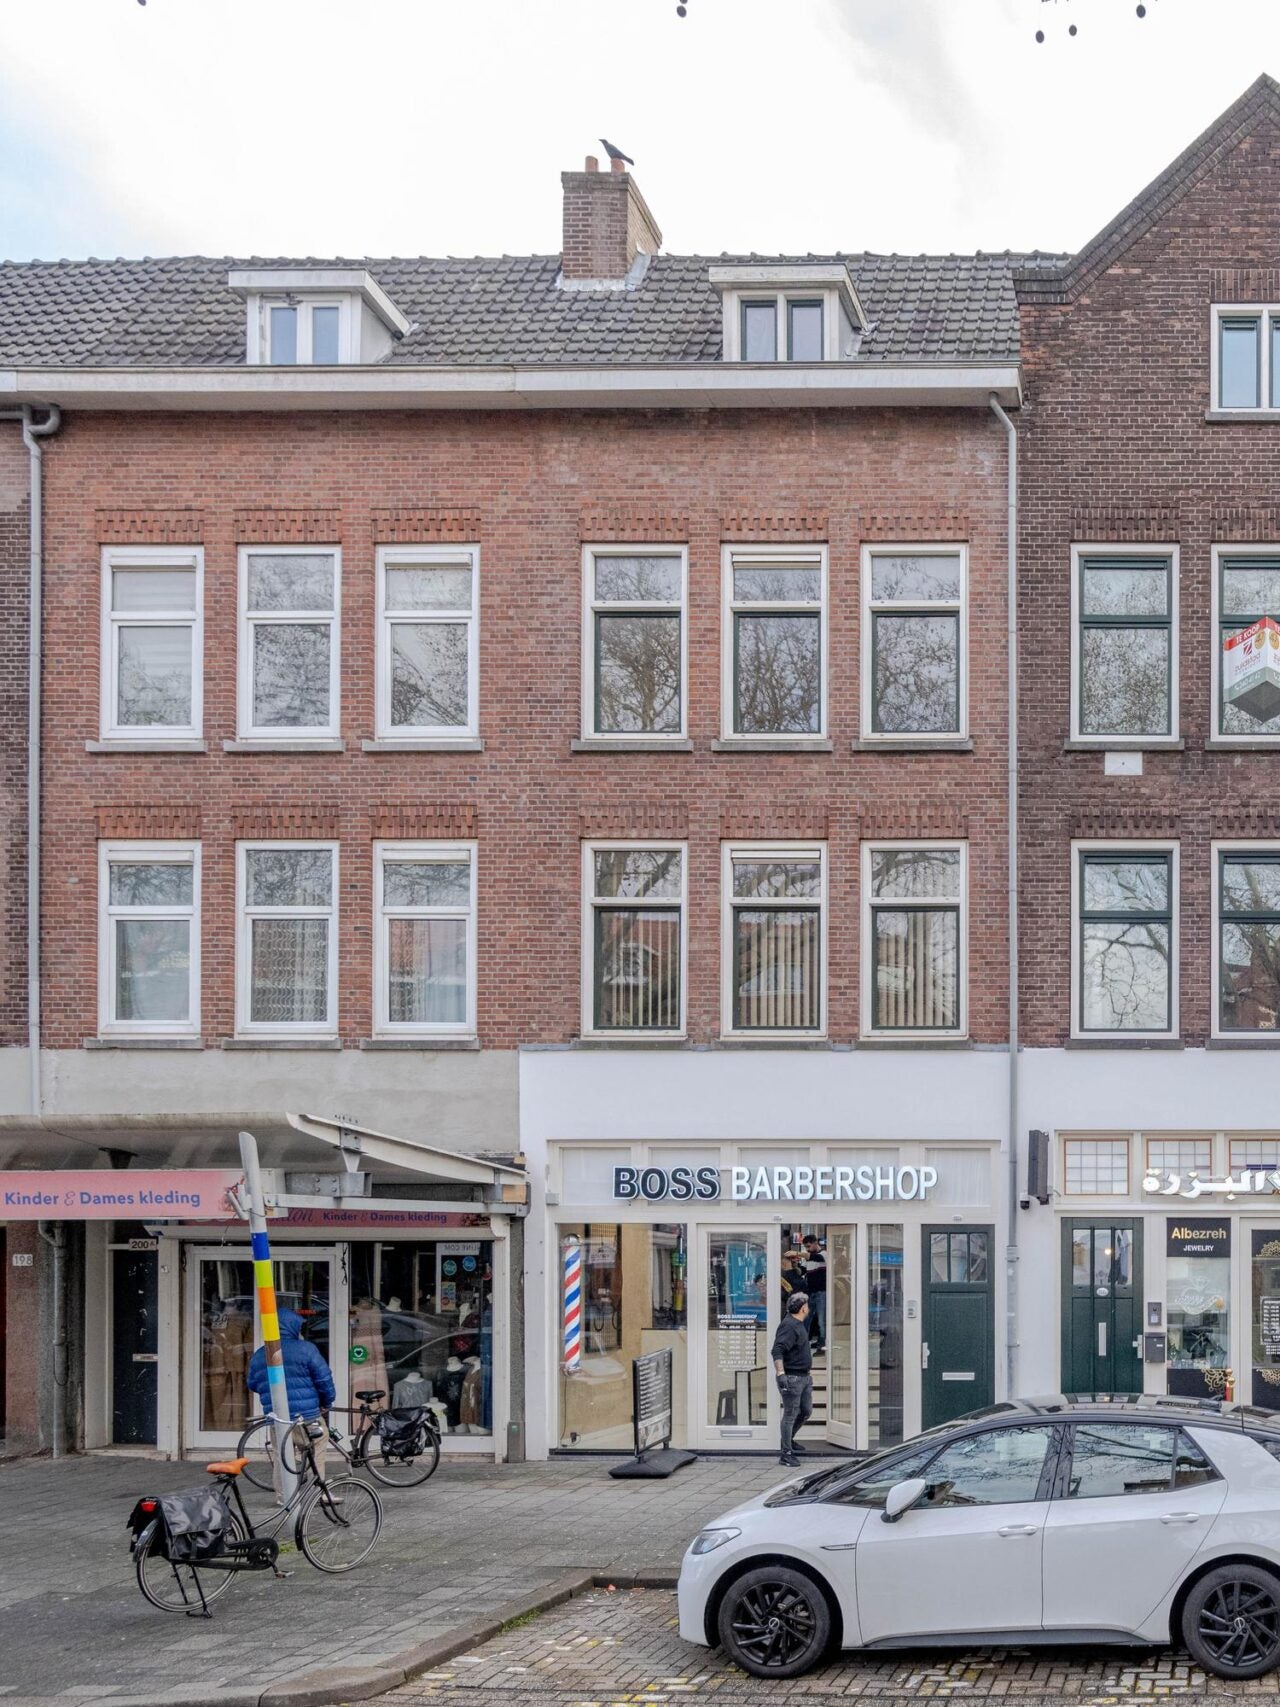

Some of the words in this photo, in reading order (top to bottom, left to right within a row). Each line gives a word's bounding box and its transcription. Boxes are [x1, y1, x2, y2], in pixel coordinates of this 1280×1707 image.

[612, 1166, 720, 1200] BOSS
[731, 1165, 938, 1200] BARBERSHOP
[5, 1192, 59, 1205] Kinder
[80, 1192, 135, 1205] Dames
[139, 1191, 200, 1207] kleding
[323, 1211, 358, 1222] Kinder
[370, 1211, 406, 1222] Dames
[408, 1212, 447, 1223] kleding
[1171, 1227, 1227, 1240] Albezreh
[1183, 1244, 1214, 1253] JEWELRY
[14, 1256, 32, 1265] 198
